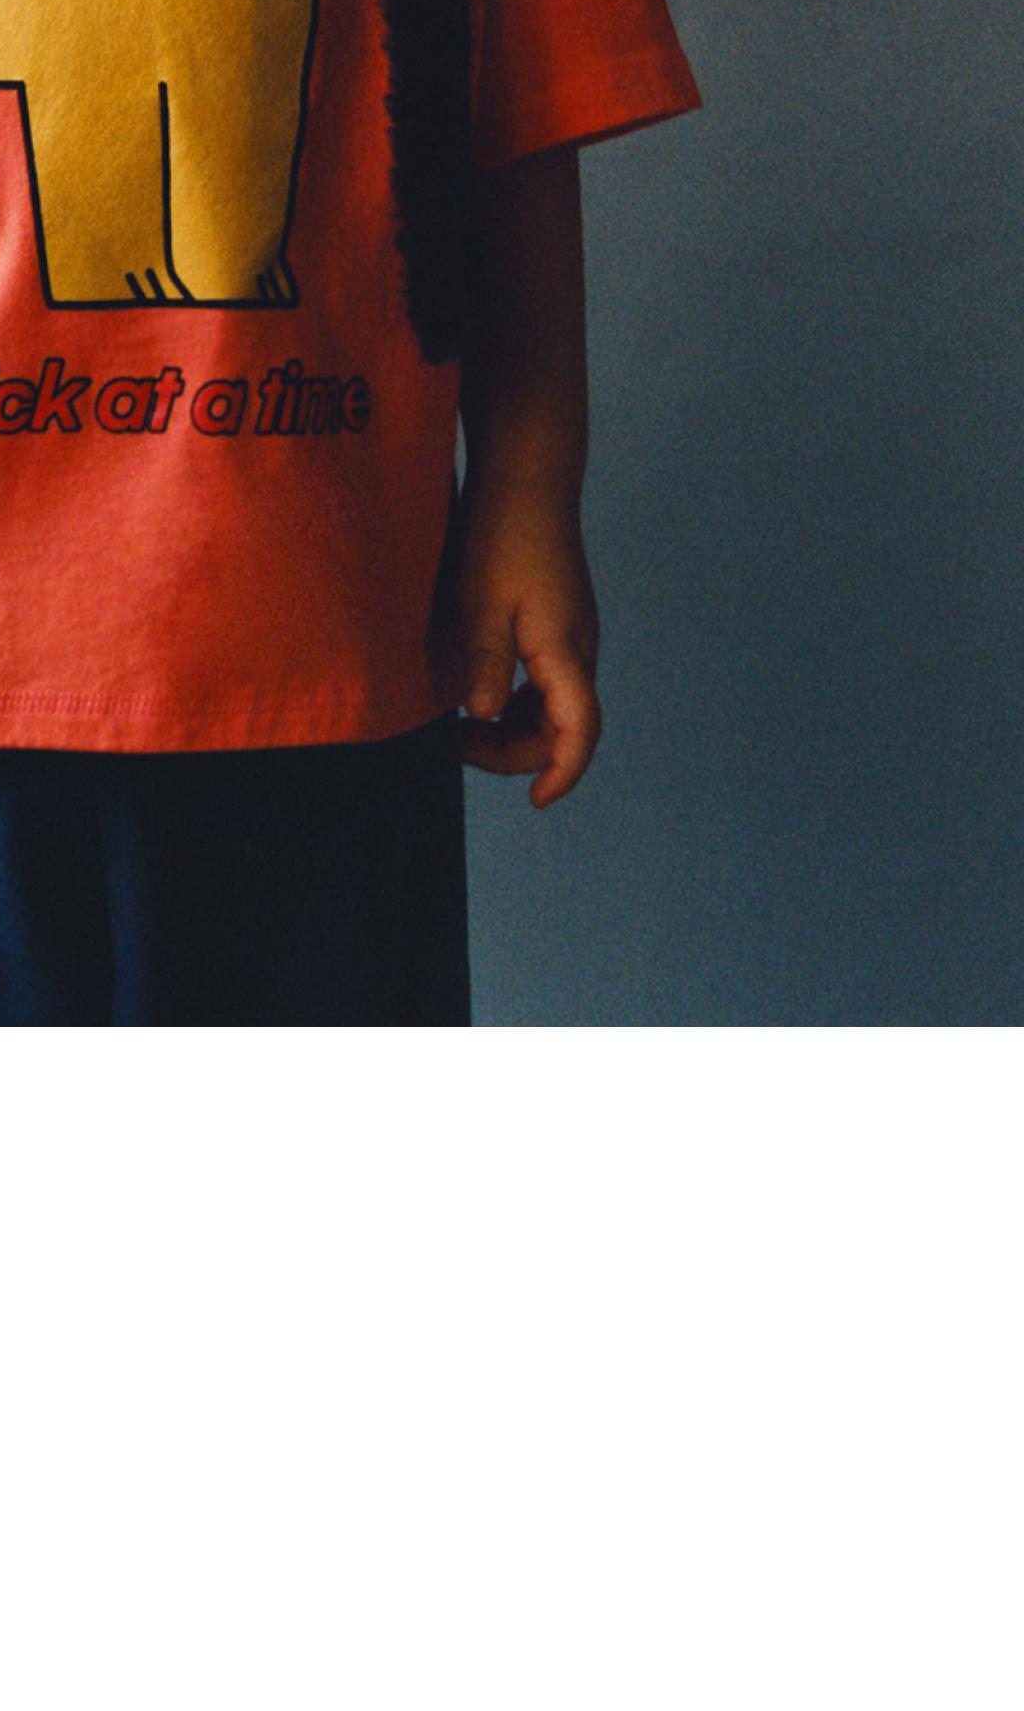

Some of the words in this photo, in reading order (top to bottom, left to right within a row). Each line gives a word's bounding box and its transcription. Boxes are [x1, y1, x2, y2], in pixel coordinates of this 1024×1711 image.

[94, 366, 185, 435] at
[191, 378, 249, 437] a
[254, 357, 371, 437] time
